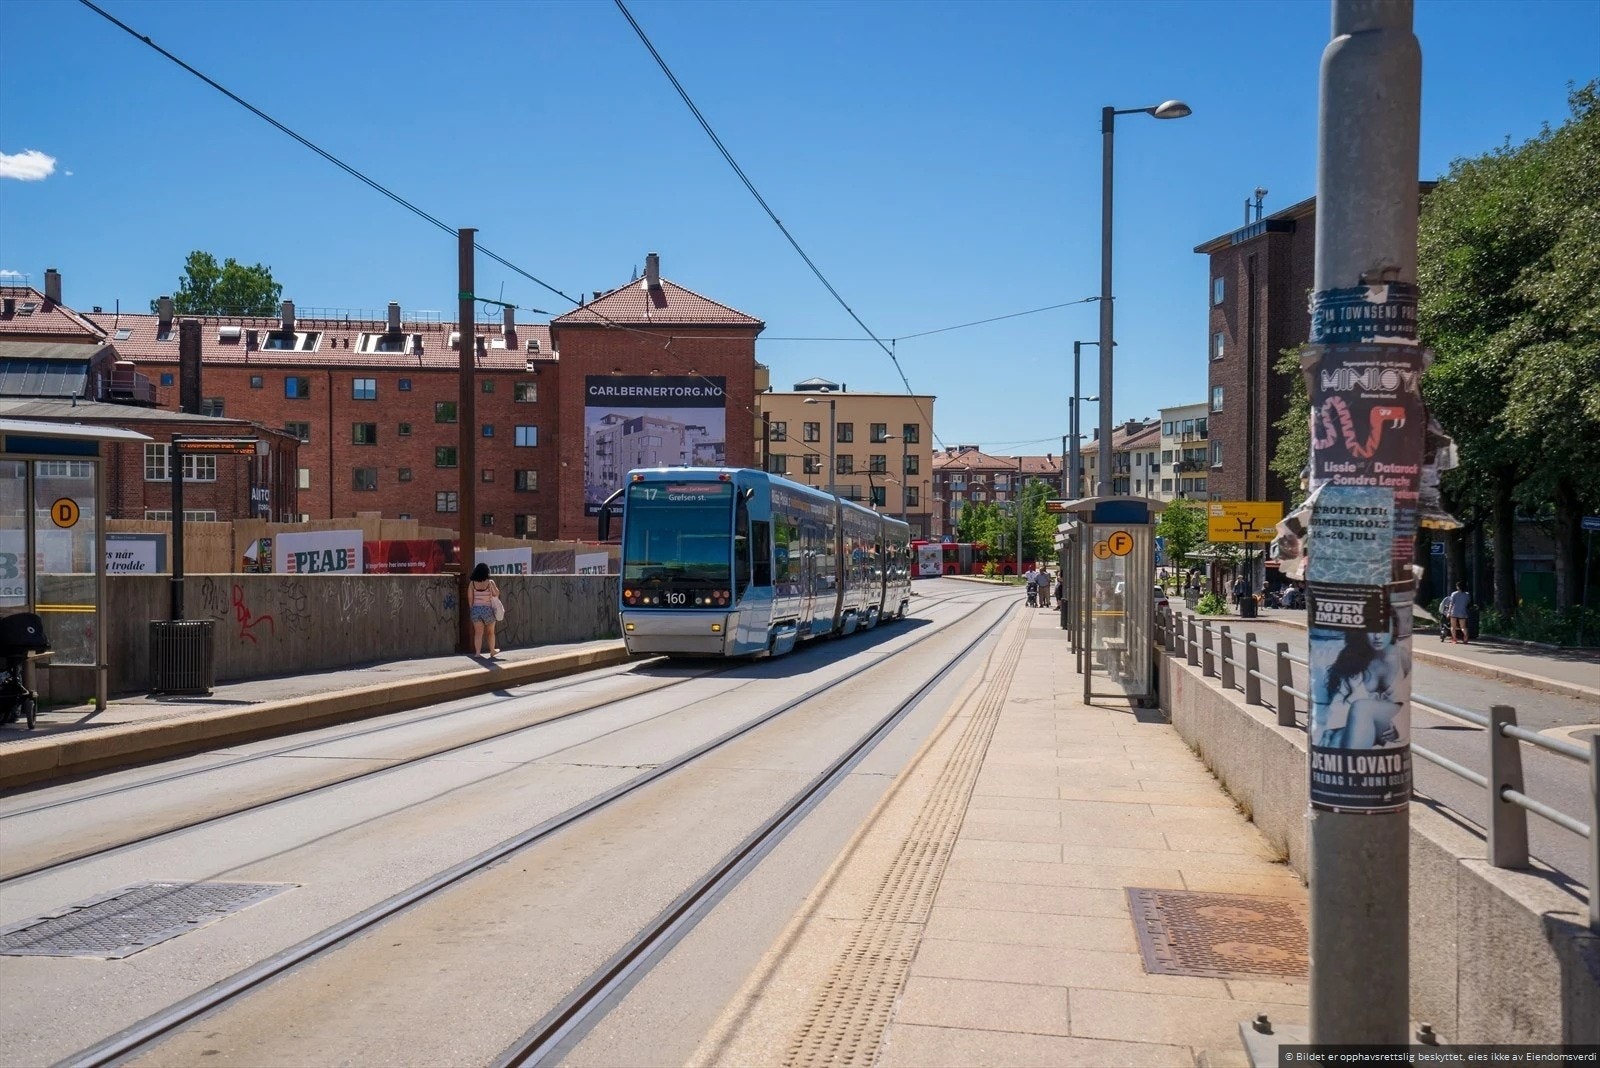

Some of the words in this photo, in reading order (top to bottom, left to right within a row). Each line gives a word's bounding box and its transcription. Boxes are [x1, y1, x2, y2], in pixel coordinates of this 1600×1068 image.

[1340, 304, 1397, 320] TOWNSEND
[589, 386, 722, 397] CARLBERNERTORG.NO
[1324, 461, 1357, 473] Lissie
[1333, 474, 1377, 486] Sondre
[644, 488, 658, 501] 17
[60, 505, 71, 521] D
[1115, 536, 1125, 551] F
[1350, 533, 1377, 542] JULI
[1099, 544, 1107, 556] F
[111, 560, 146, 571] trodde
[294, 548, 349, 574] PEAB
[665, 593, 686, 604] 160
[1316, 601, 1364, 614] TØYEN
[1315, 611, 1365, 624] IMPRO
[1312, 751, 1343, 773] DEMI
[1347, 754, 1402, 774] LOVATO
[1313, 772, 1345, 786] FREDAG
[1361, 776, 1387, 787] JUNI
